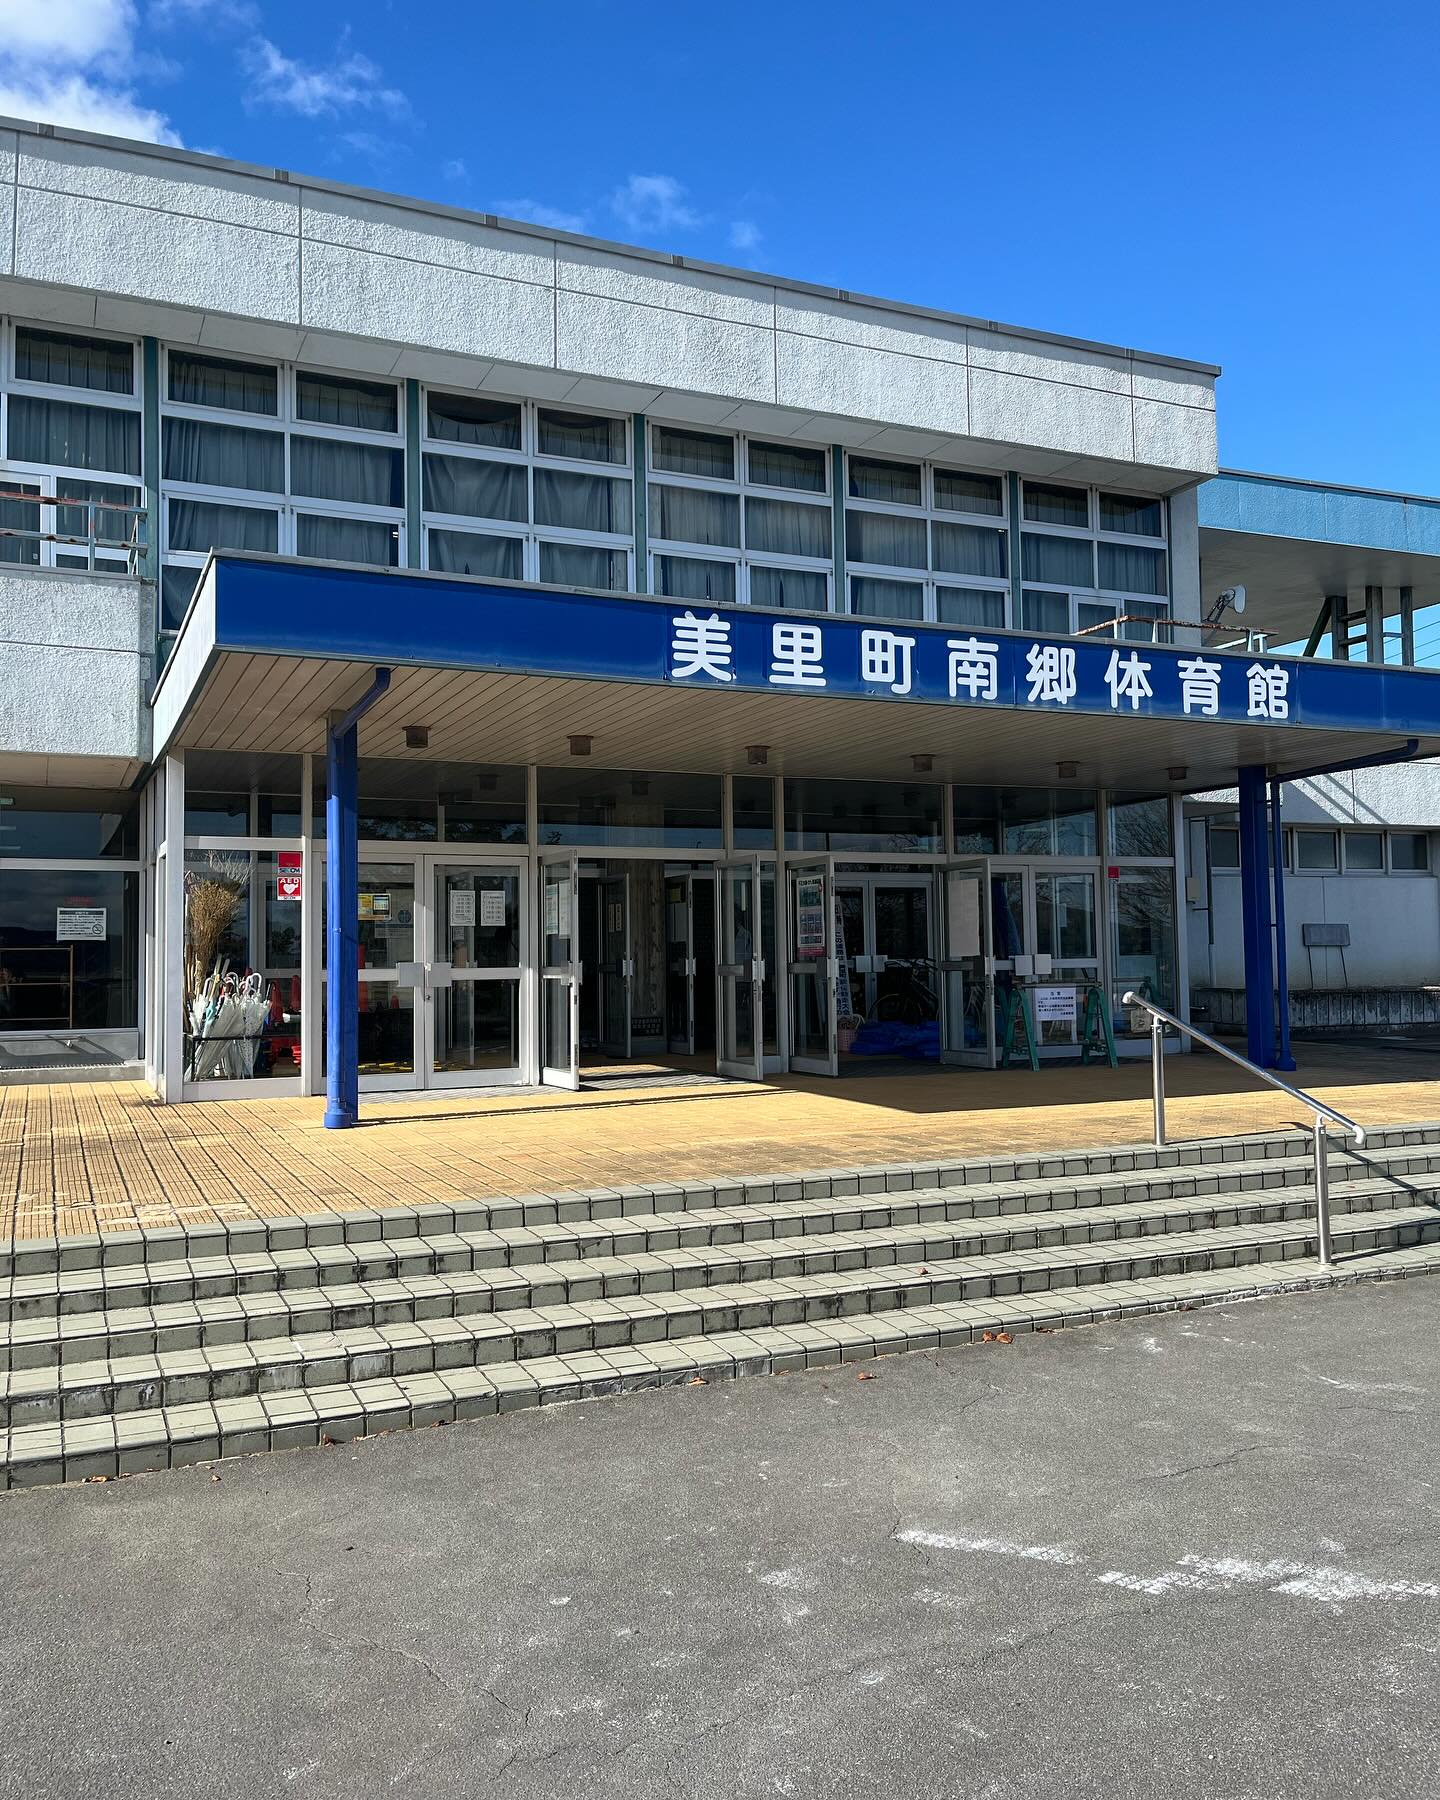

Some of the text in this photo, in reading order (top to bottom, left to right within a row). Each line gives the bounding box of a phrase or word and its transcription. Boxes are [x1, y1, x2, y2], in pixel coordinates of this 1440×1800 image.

[671, 611, 1289, 719] 美里町南郷体育館
